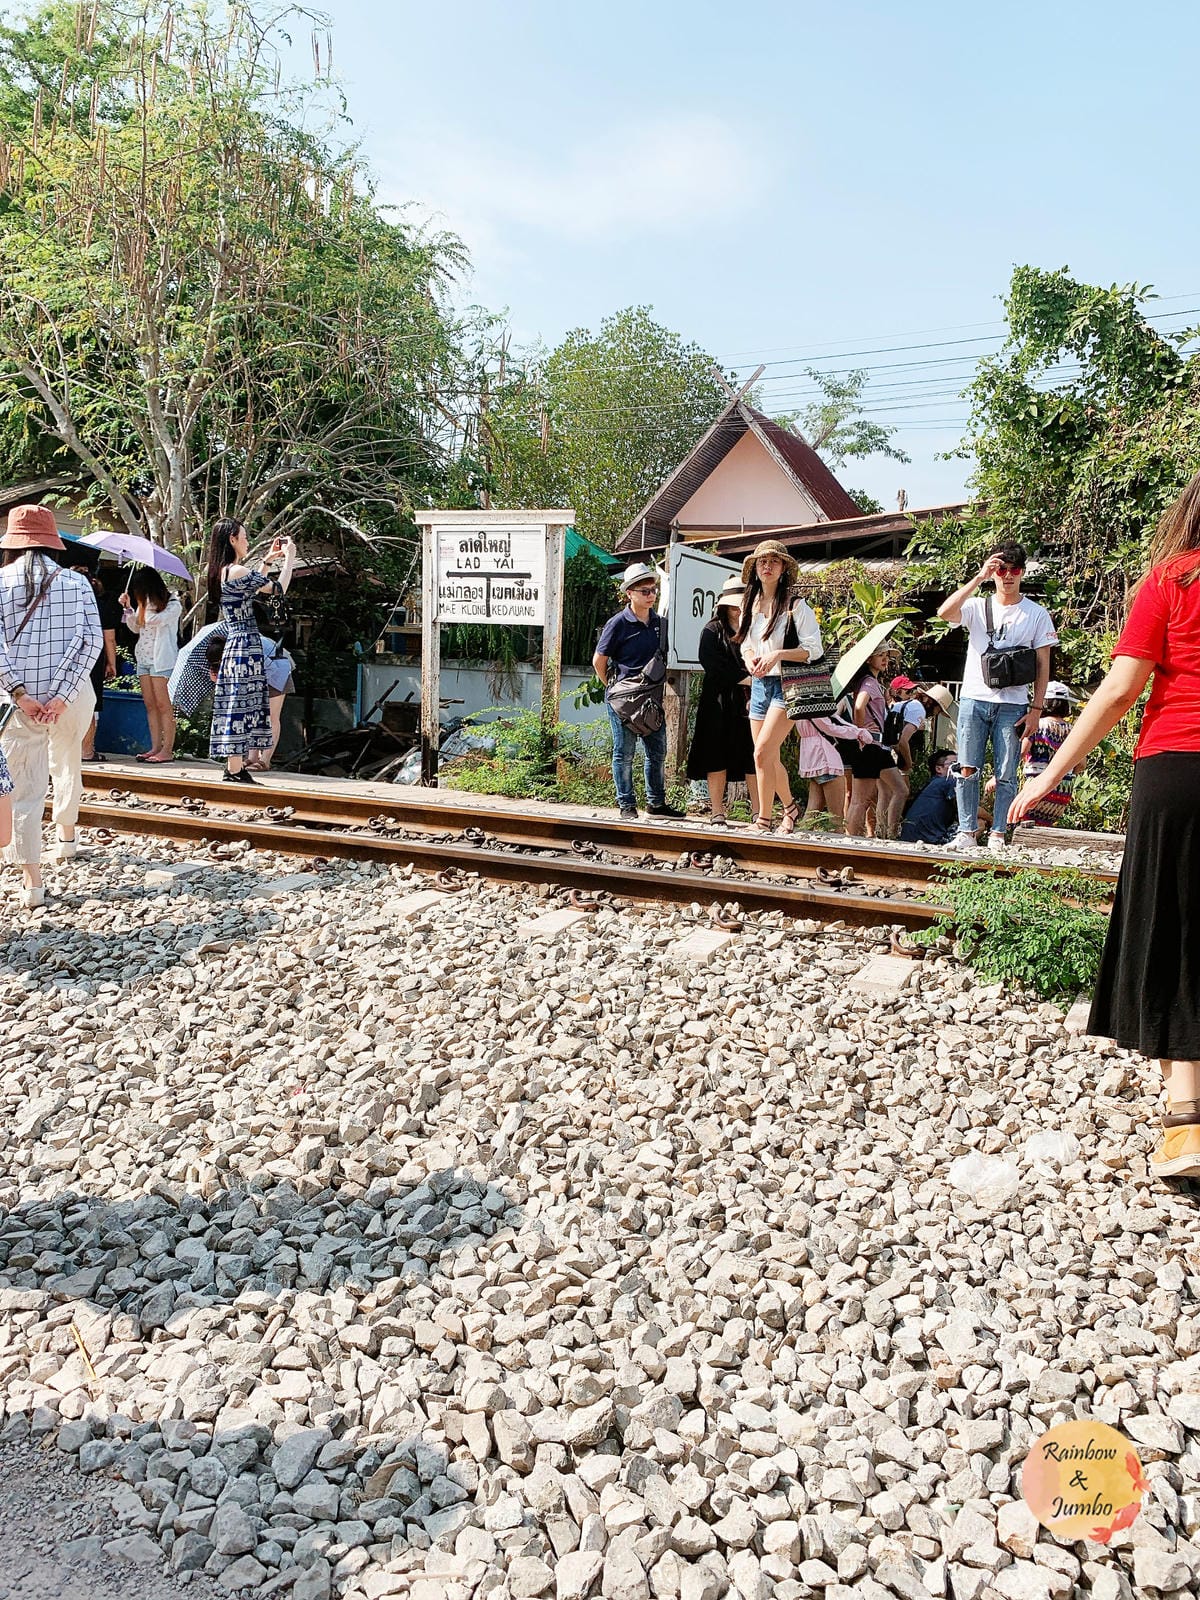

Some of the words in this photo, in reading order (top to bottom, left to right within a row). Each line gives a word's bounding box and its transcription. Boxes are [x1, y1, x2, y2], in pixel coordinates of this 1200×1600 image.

[459, 531, 511, 557] ลาดใหญ่
[457, 557, 480, 569] LAD
[494, 558, 514, 569] YAI
[439, 582, 483, 600] แม่กลอง
[439, 603, 456, 615] MAE
[461, 604, 486, 615] KLONG
[692, 587, 721, 618] ลา
